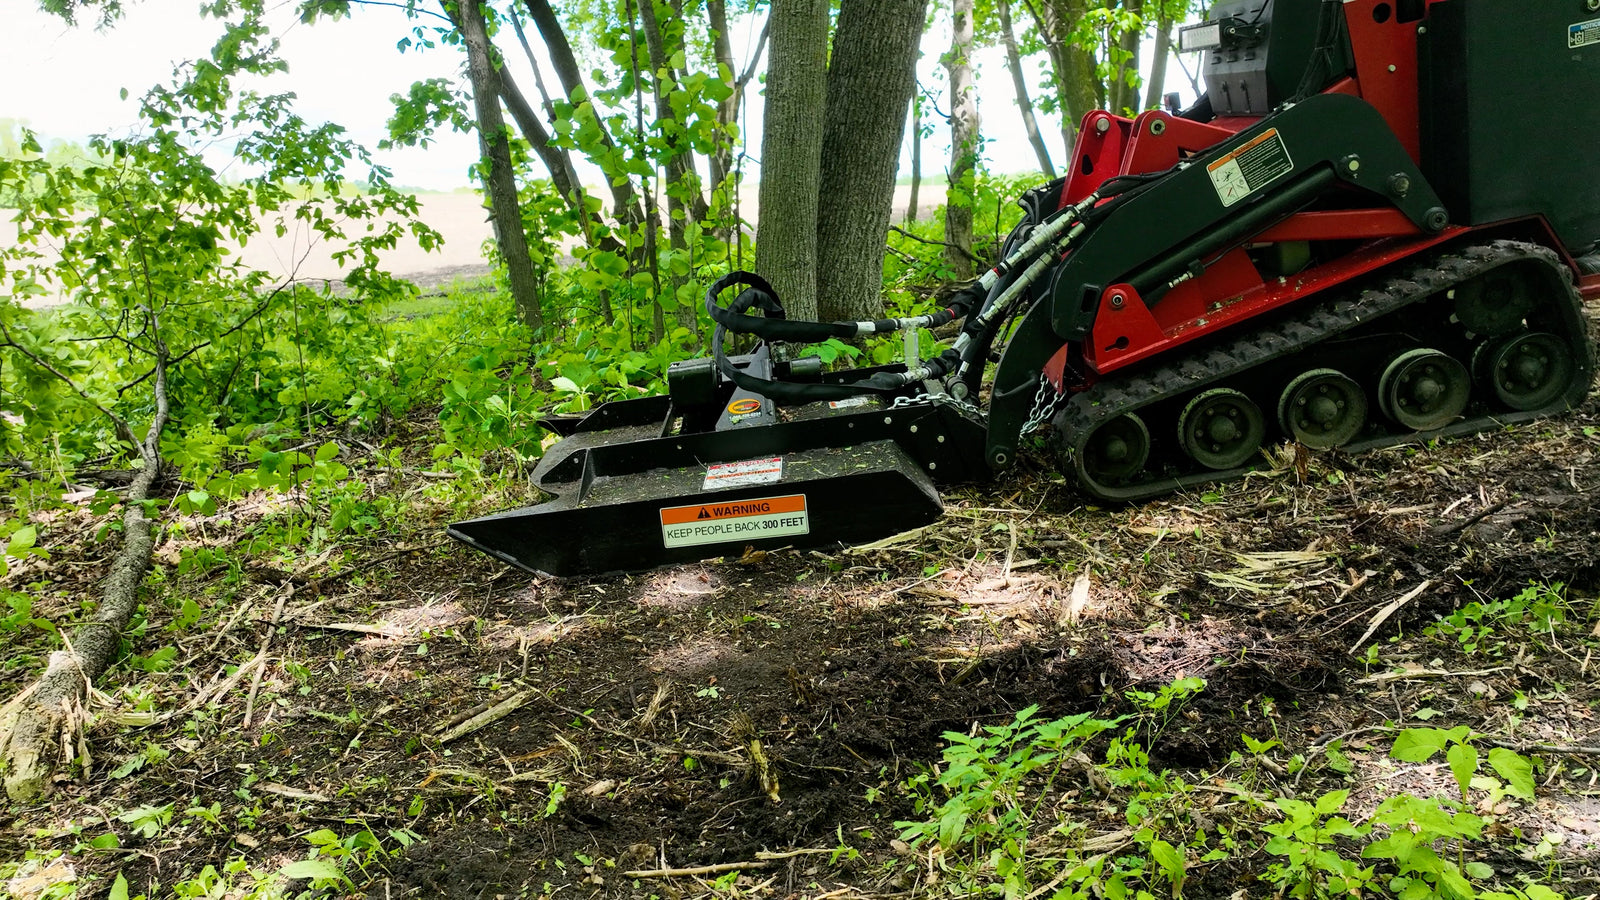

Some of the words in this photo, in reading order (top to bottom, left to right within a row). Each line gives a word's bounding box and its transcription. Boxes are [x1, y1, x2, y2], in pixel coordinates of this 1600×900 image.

[713, 502, 771, 517] WARNING
[667, 527, 693, 539] KEEP
[695, 523, 733, 537] PEOPLE
[735, 520, 761, 533] BACK
[762, 519, 779, 530] 300
[780, 516, 805, 528] FEET
